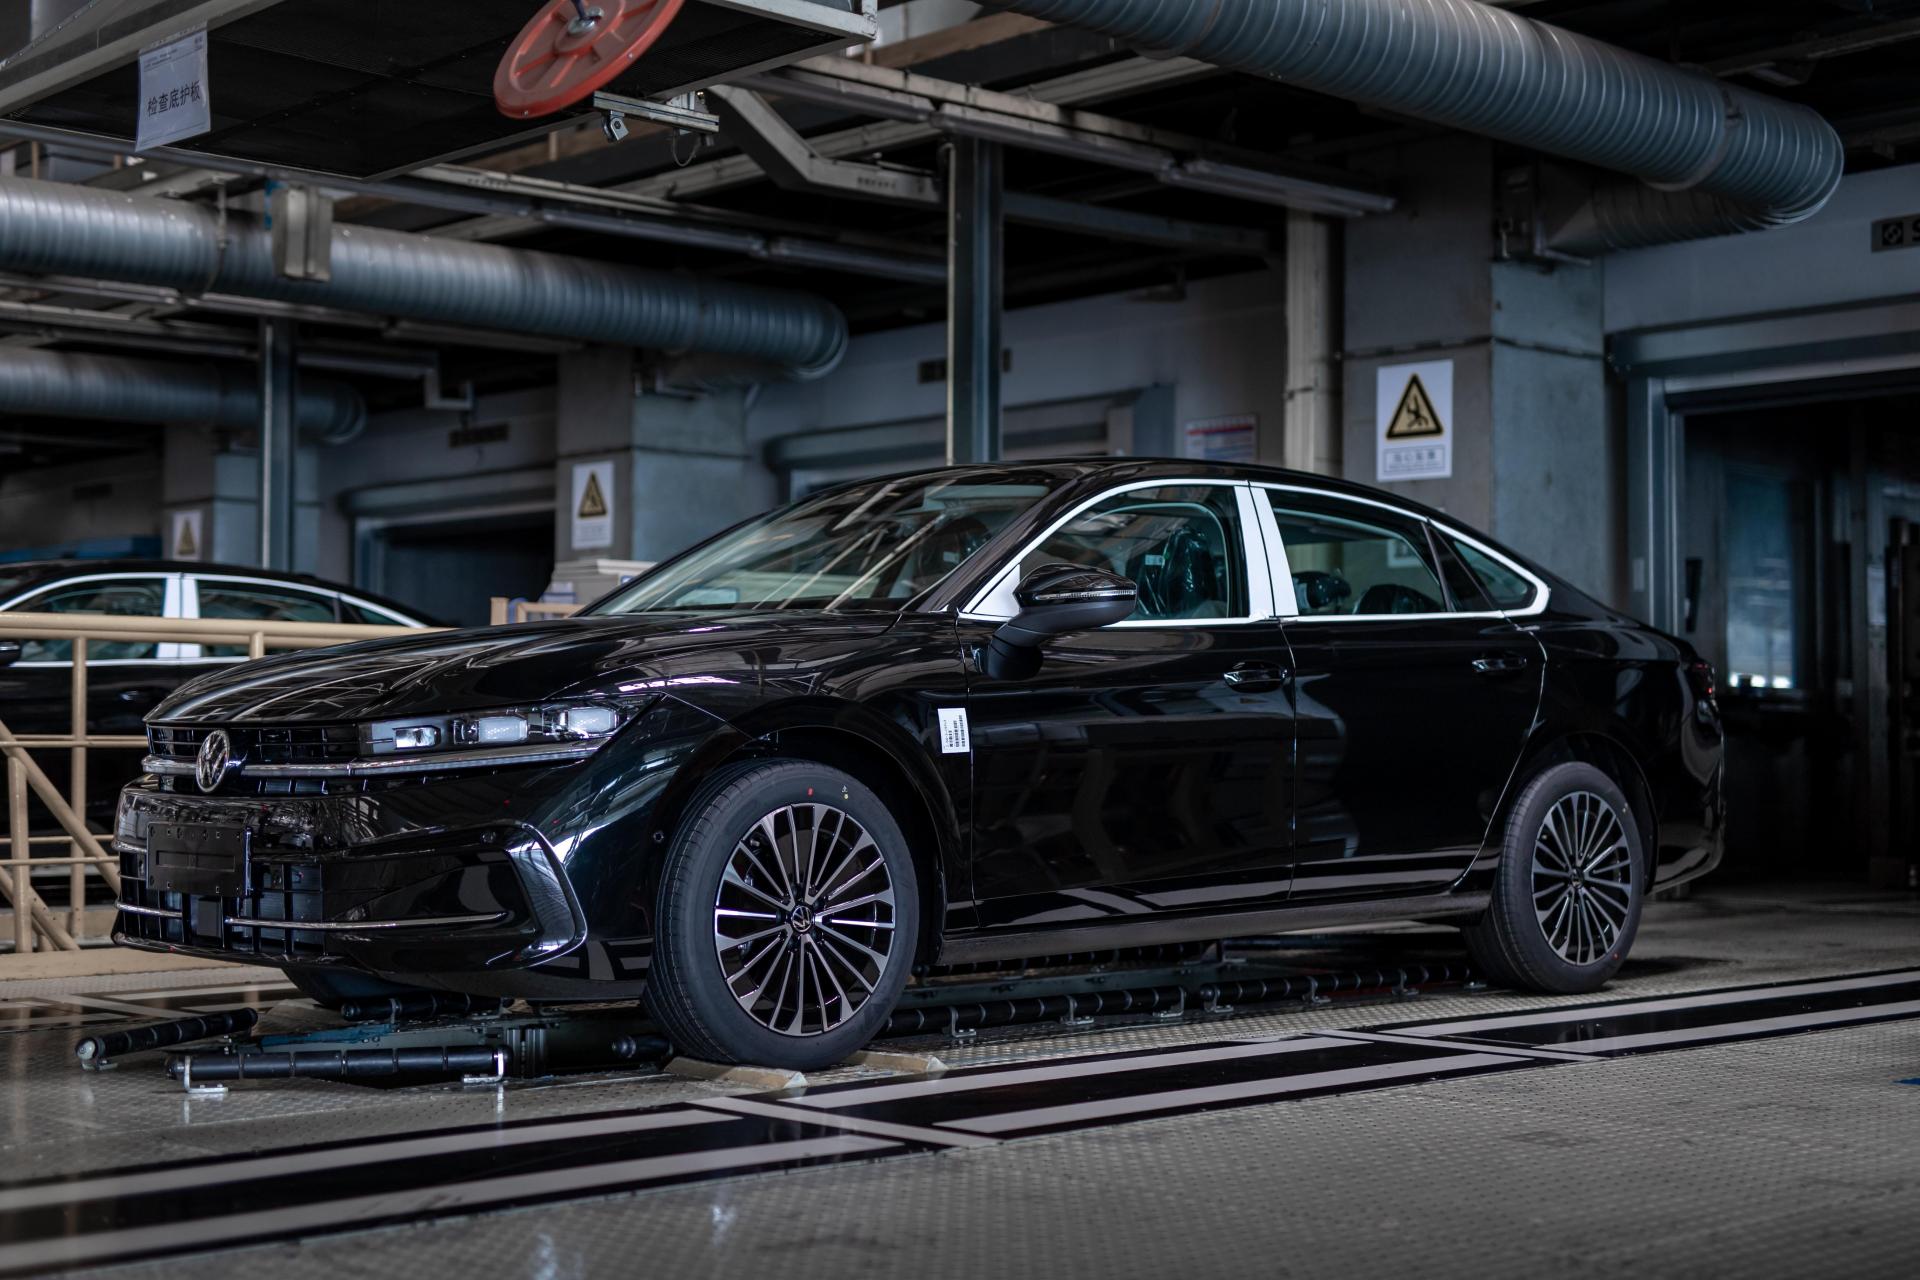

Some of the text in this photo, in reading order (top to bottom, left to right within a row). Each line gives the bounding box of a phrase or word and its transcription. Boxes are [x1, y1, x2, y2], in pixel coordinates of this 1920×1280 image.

[147, 81, 201, 117] 检查底护板
